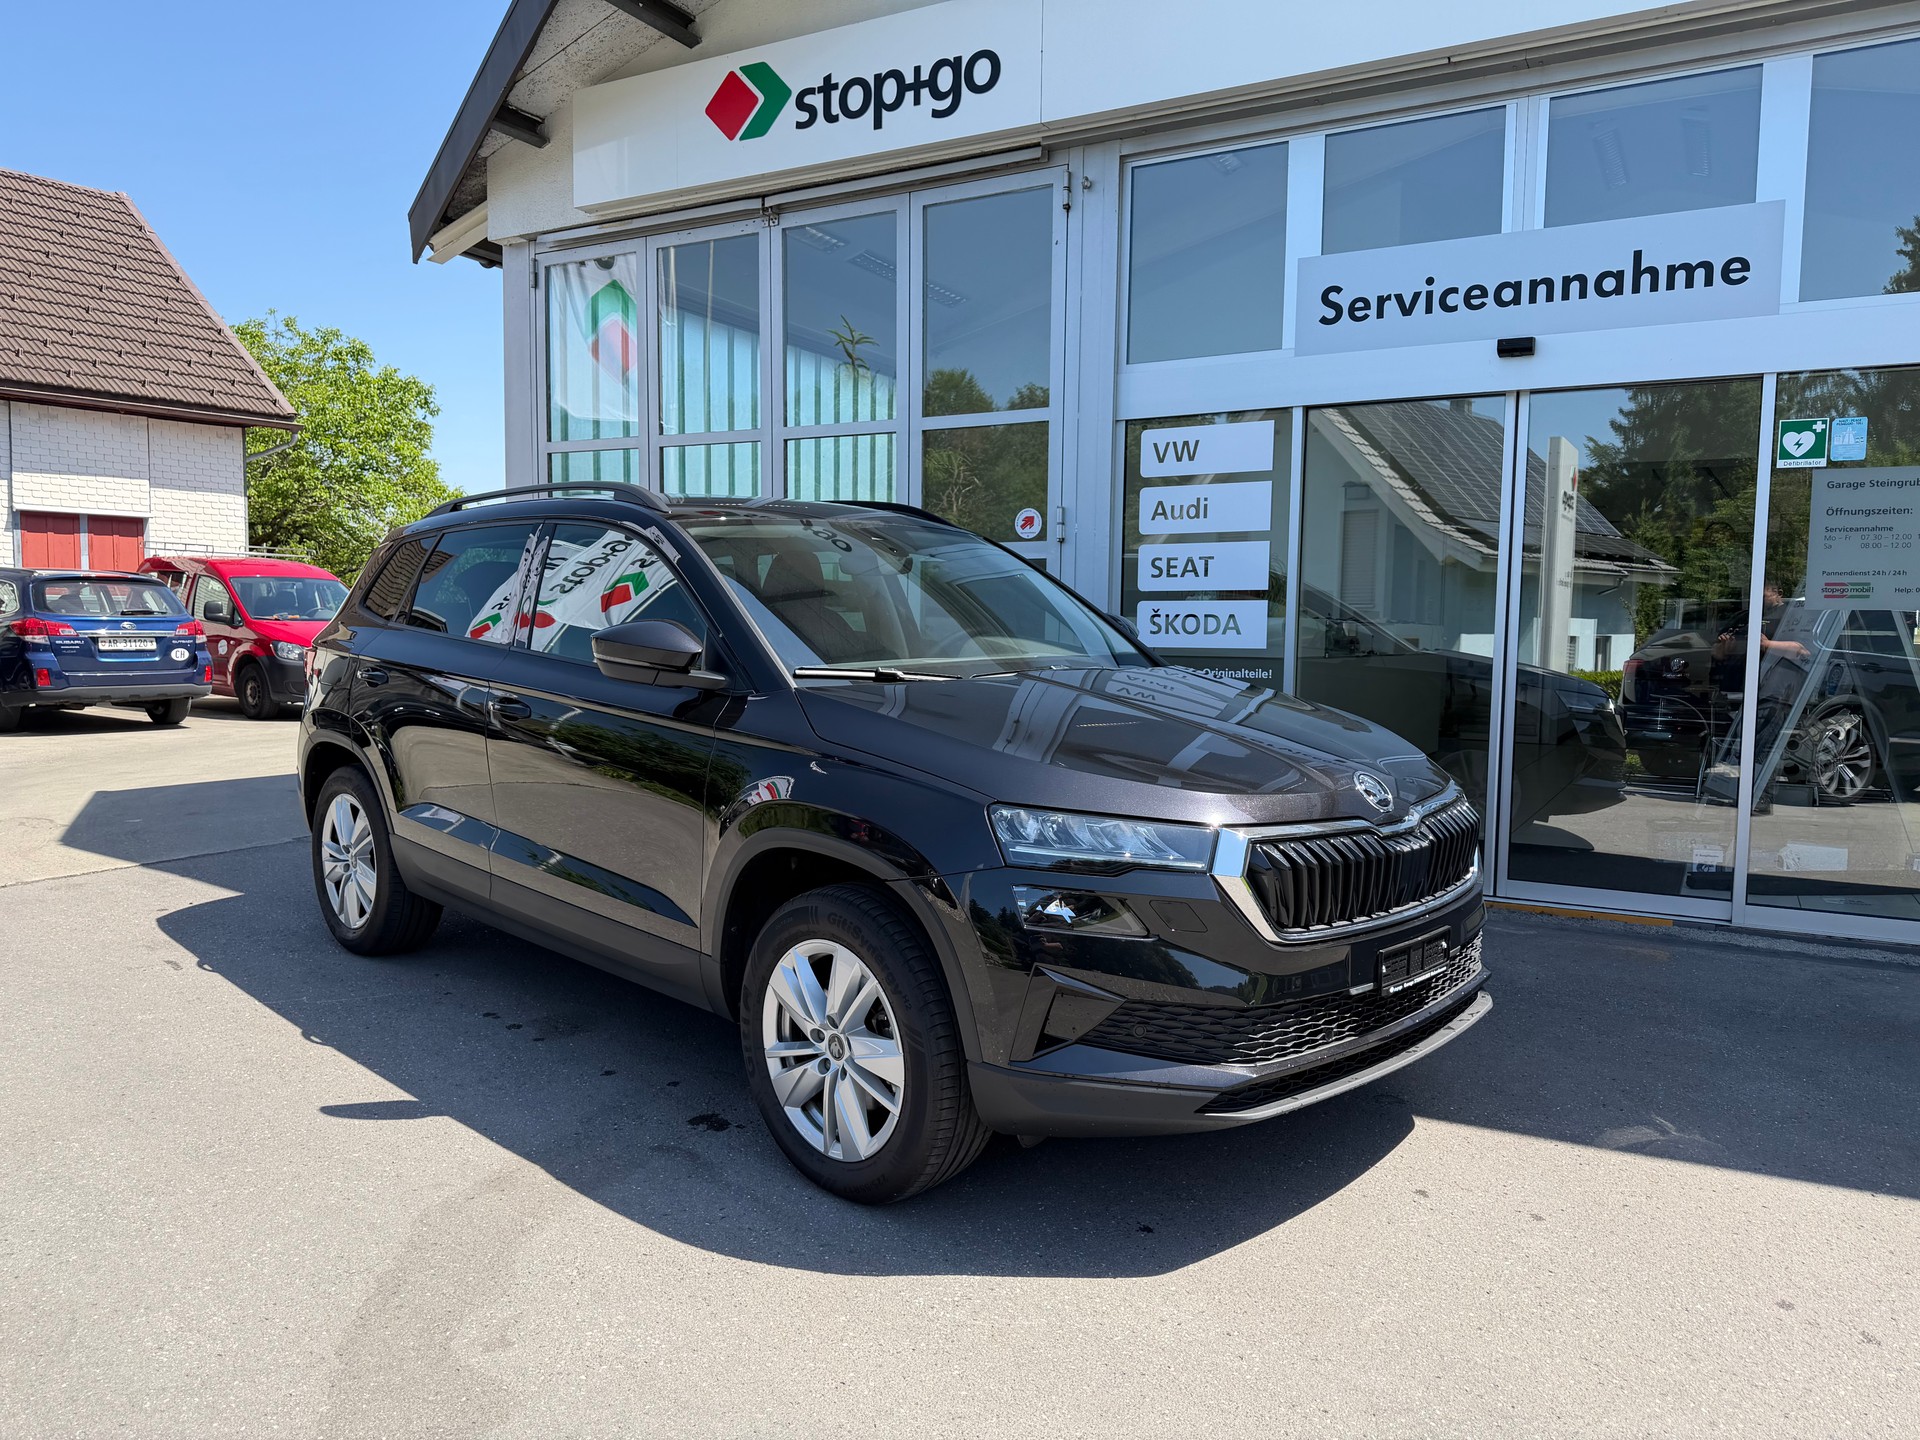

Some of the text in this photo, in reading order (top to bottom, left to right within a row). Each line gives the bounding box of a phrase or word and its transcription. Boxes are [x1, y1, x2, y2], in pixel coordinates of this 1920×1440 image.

[795, 49, 1002, 131] stop+go
[1318, 249, 1751, 326] Serviceannahme
[1153, 439, 1200, 464] VW
[1826, 480, 1866, 491] Garage
[1150, 496, 1209, 521] Audi
[1826, 506, 1914, 518] Öffnungszeiten:
[1824, 524, 1894, 533] Serviceannahme
[1823, 542, 1833, 550] Sa
[1151, 556, 1215, 578] SEAT
[1149, 608, 1242, 635] ŠKODA
[174, 650, 186, 659] CH
